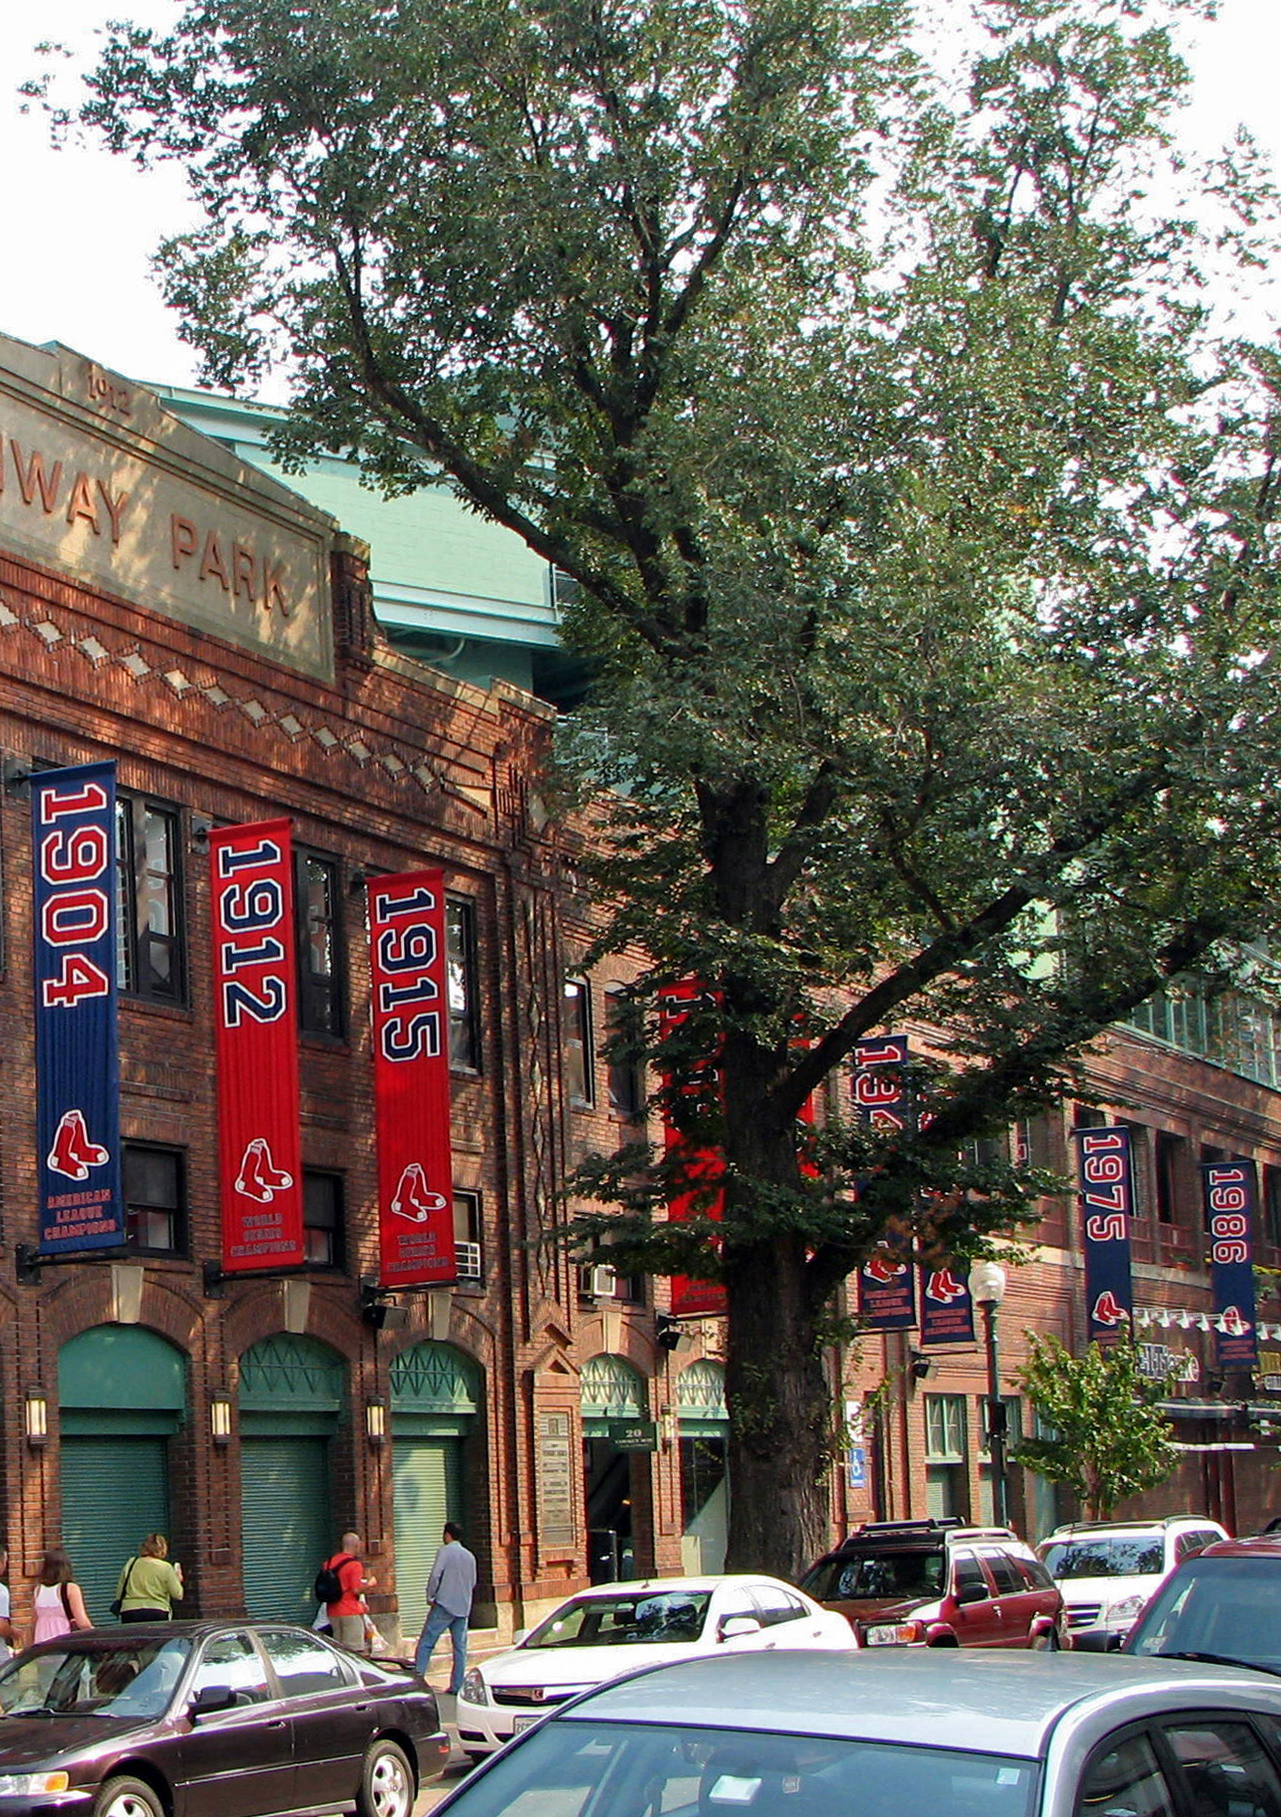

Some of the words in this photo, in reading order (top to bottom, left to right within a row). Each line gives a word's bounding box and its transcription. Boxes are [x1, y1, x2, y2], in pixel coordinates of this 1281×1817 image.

[87, 362, 132, 417] 1912
[171, 512, 290, 617] PARK
[40, 782, 109, 1009] 1904
[217, 838, 287, 1029] 1912
[374, 885, 440, 1064] 1915
[44, 1219, 117, 1240] CHAMPIONS
[47, 1188, 112, 1209] AMERICAN
[56, 1205, 103, 1223] LEAGUE
[1083, 1134, 1125, 1242] 1975
[1209, 1168, 1247, 1264] 1986
[625, 1428, 642, 1438] 20
